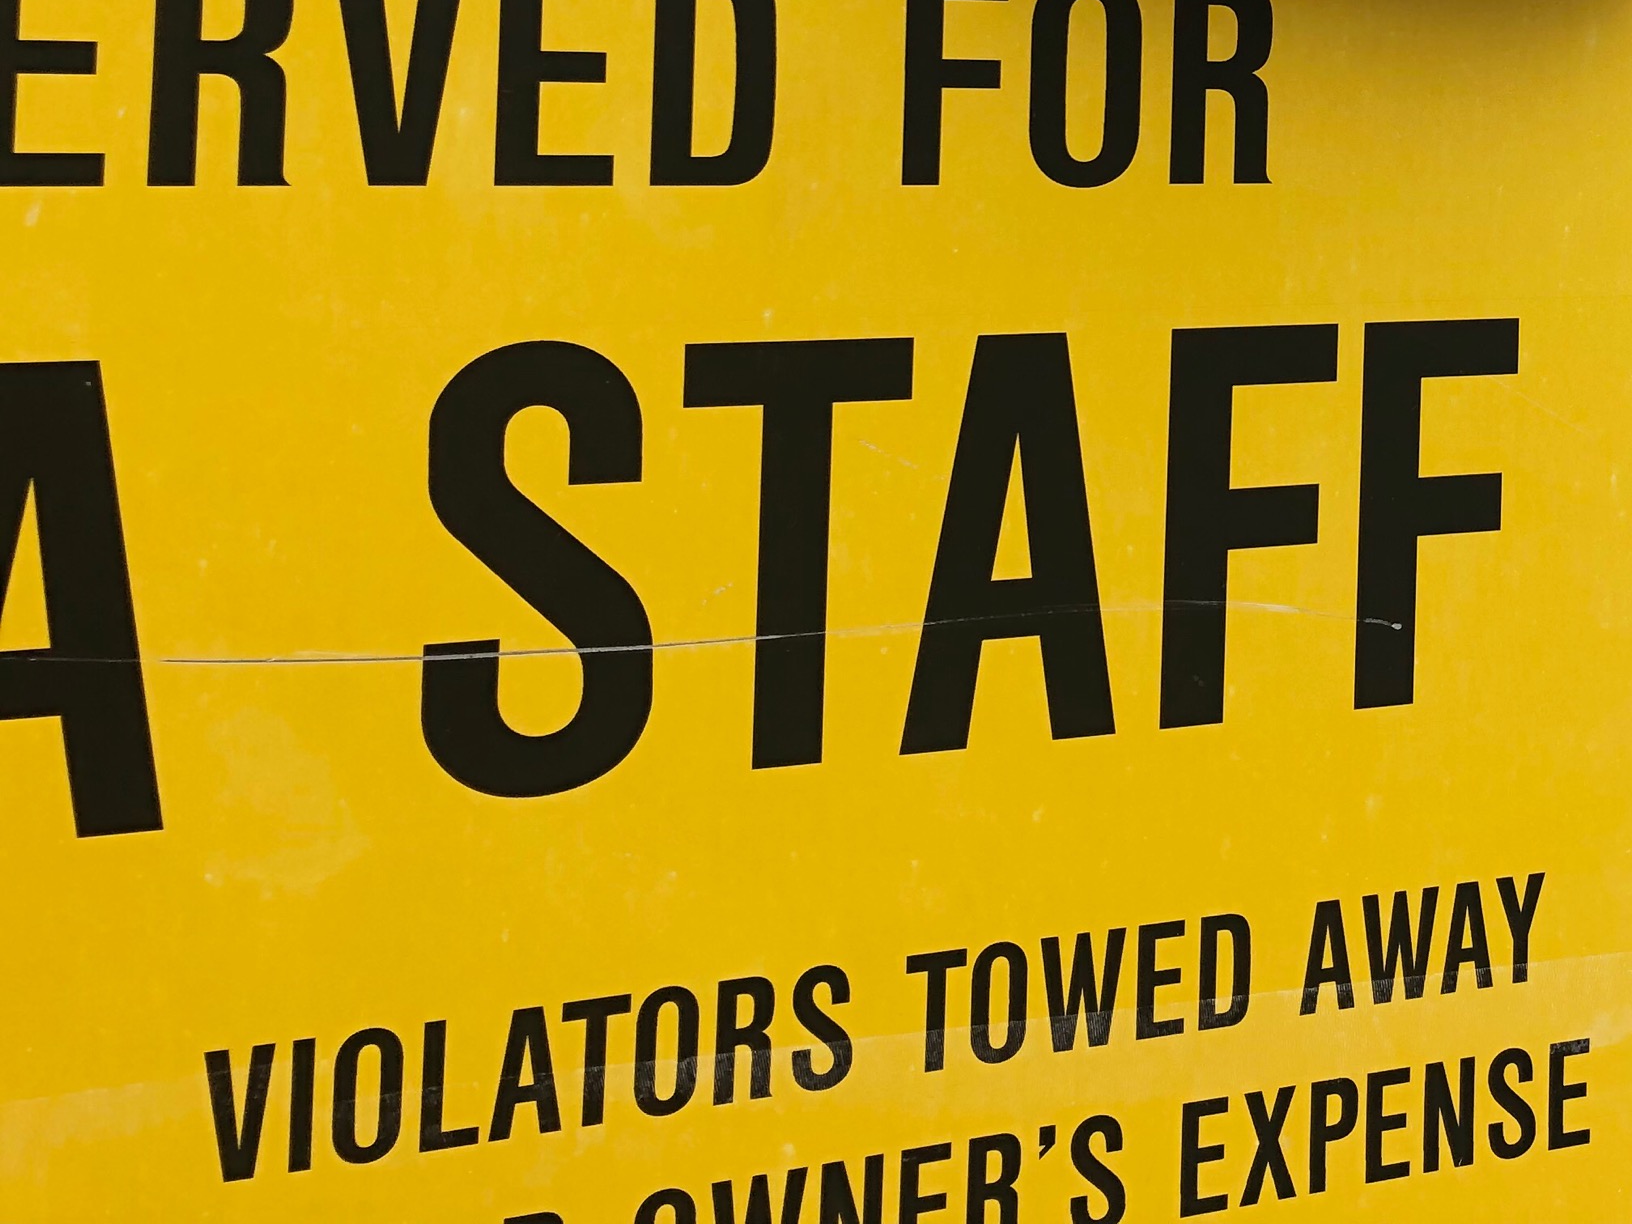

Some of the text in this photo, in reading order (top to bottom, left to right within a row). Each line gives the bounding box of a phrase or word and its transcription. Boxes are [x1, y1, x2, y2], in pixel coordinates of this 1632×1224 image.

[420, 317, 1520, 798] STAFF
[203, 872, 1546, 1183] VIOLATORS TOWED AWAY
[634, 1038, 1591, 1224] NER'S EXPENSE
